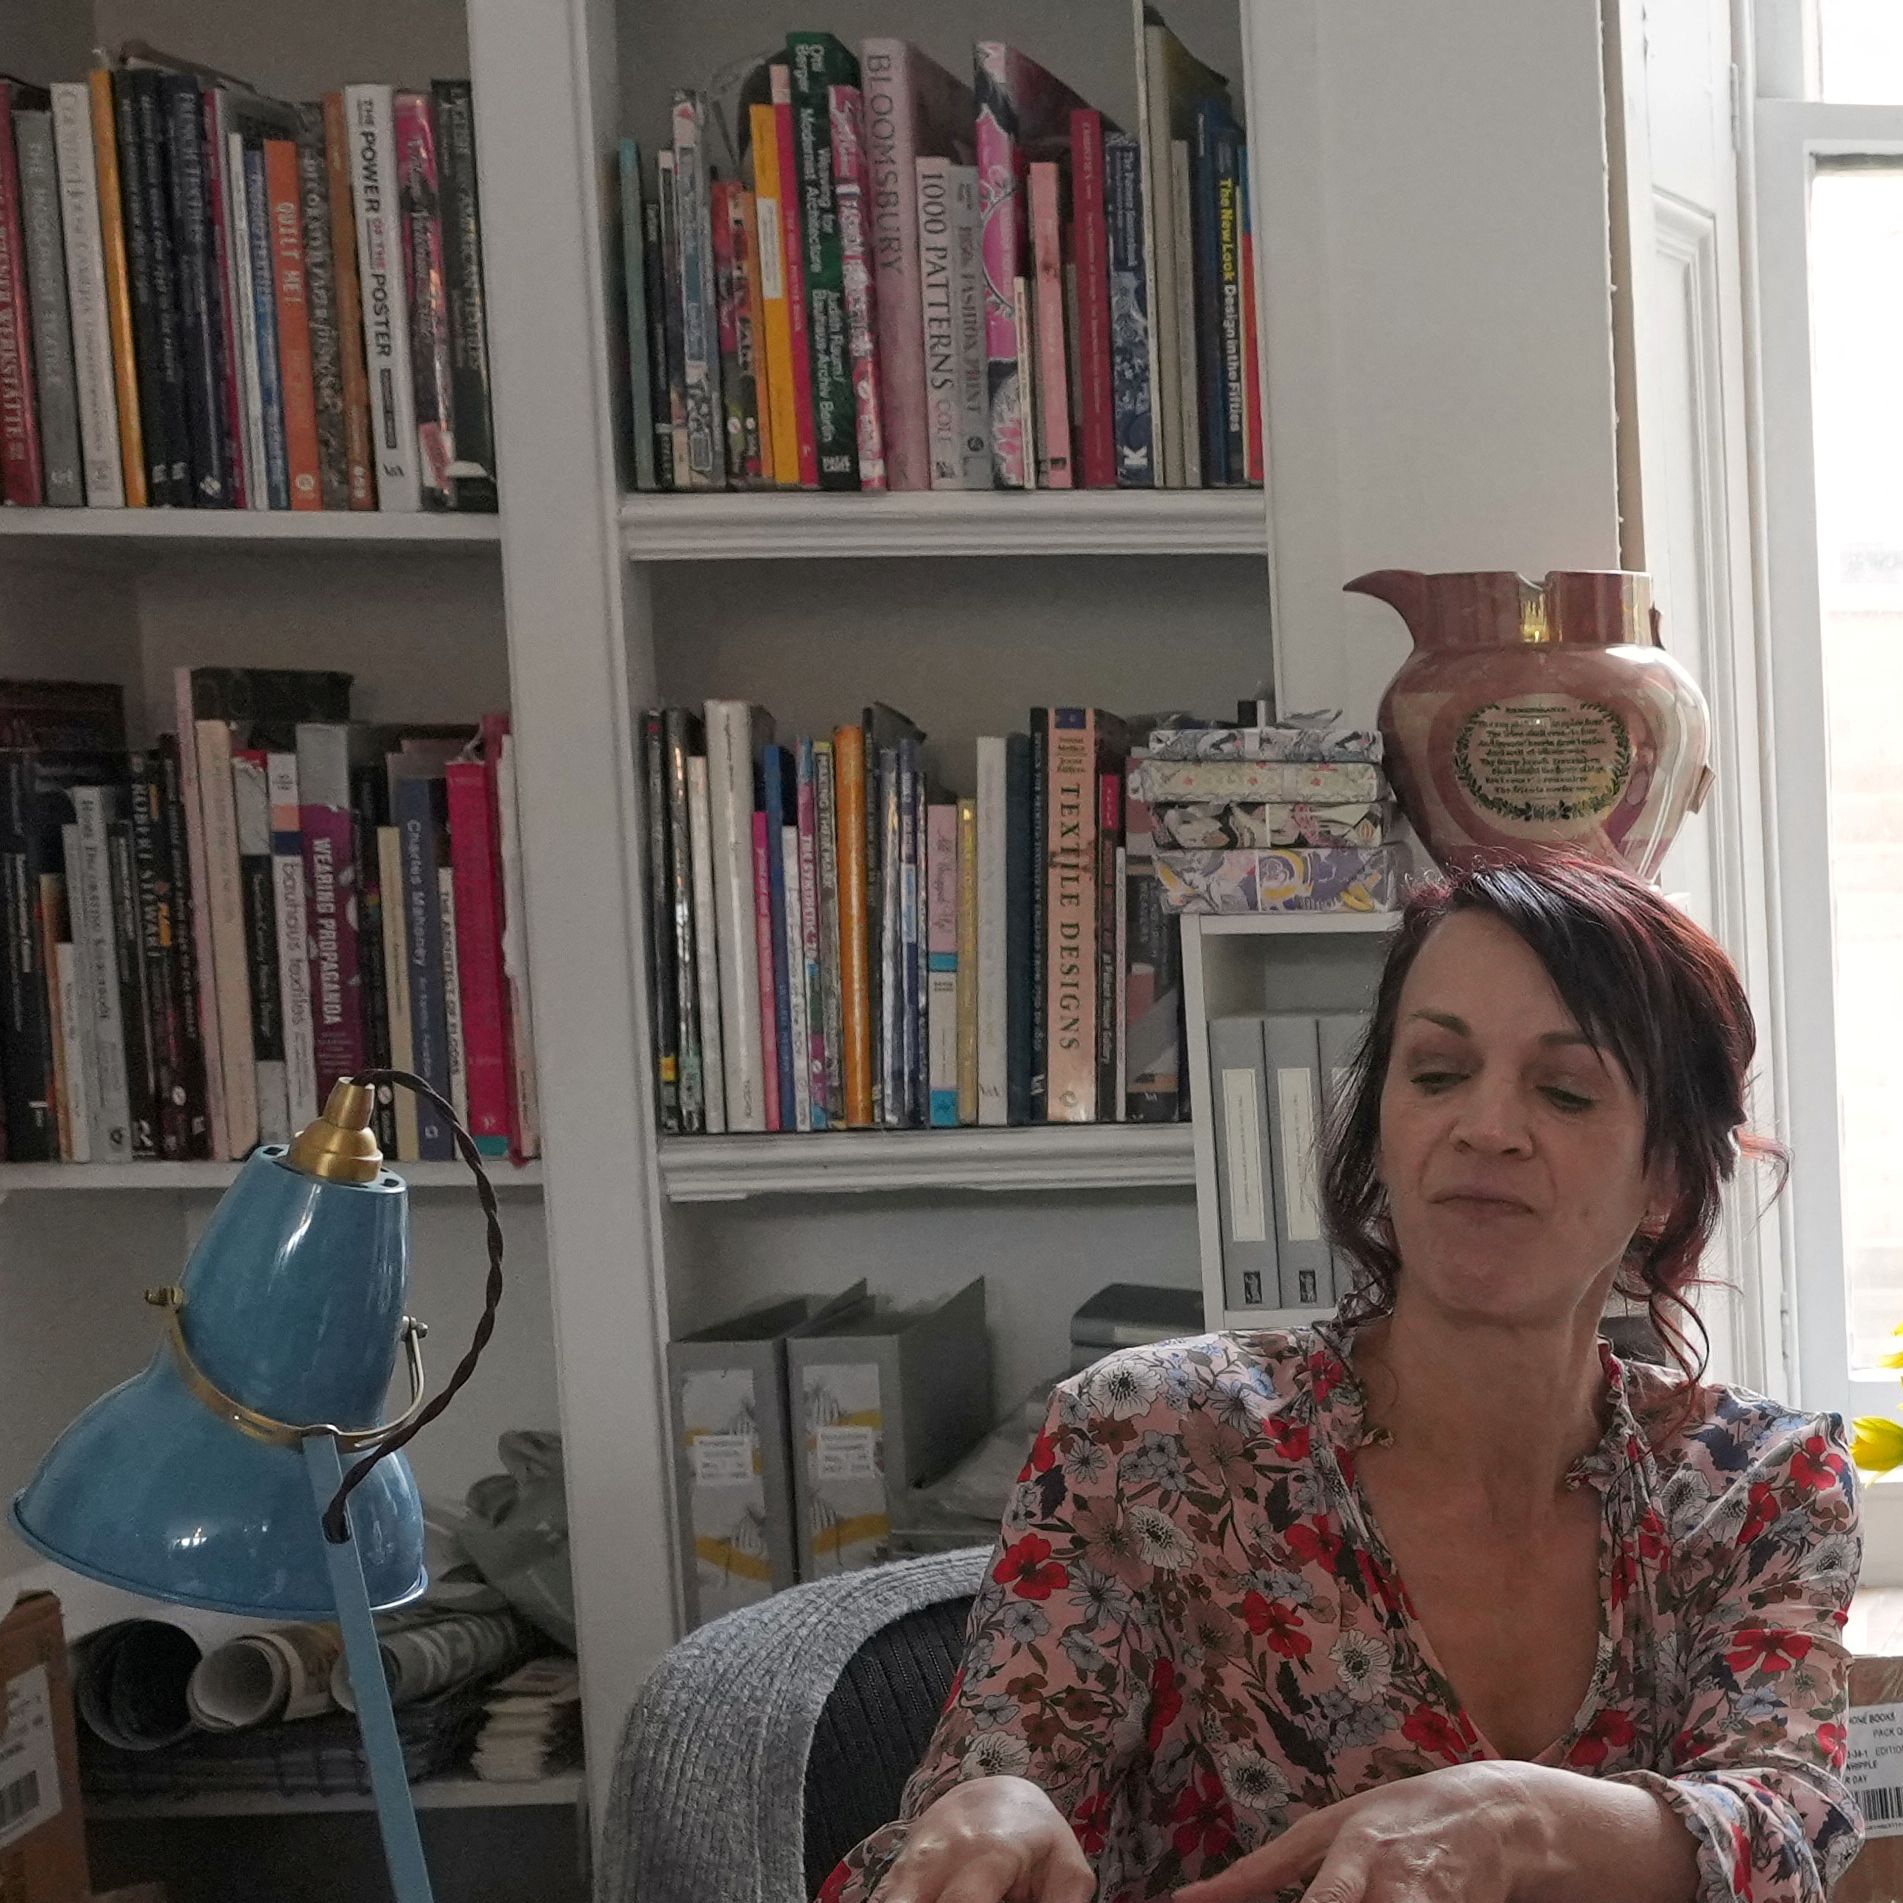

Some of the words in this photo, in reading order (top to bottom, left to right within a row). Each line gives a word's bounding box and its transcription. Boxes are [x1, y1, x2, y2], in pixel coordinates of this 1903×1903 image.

[865, 54, 904, 277] BLOOMSBURY
[921, 171, 947, 236] 1000
[1217, 178, 1234, 208] The
[278, 202, 297, 257] QUILT
[360, 131, 381, 213] POWER
[371, 272, 393, 357] POSTER
[805, 185, 824, 274] Architecture
[1219, 208, 1236, 244] New
[1221, 243, 1238, 282] Look
[924, 246, 957, 391] PATTERNS
[962, 274, 979, 350] FASHION
[1221, 284, 1240, 337] Design
[1226, 381, 1242, 433] Fifties
[312, 838, 336, 914] WEARING
[406, 819, 423, 885] Charles
[1060, 783, 1082, 909] TEXTILE
[283, 862, 307, 951] bauhaus
[409, 891, 427, 967] Mahoney
[317, 917, 343, 1025] PROPAGANDA
[1059, 920, 1081, 1052] DESIGNS
[1873, 1727, 1895, 1738] PACK
